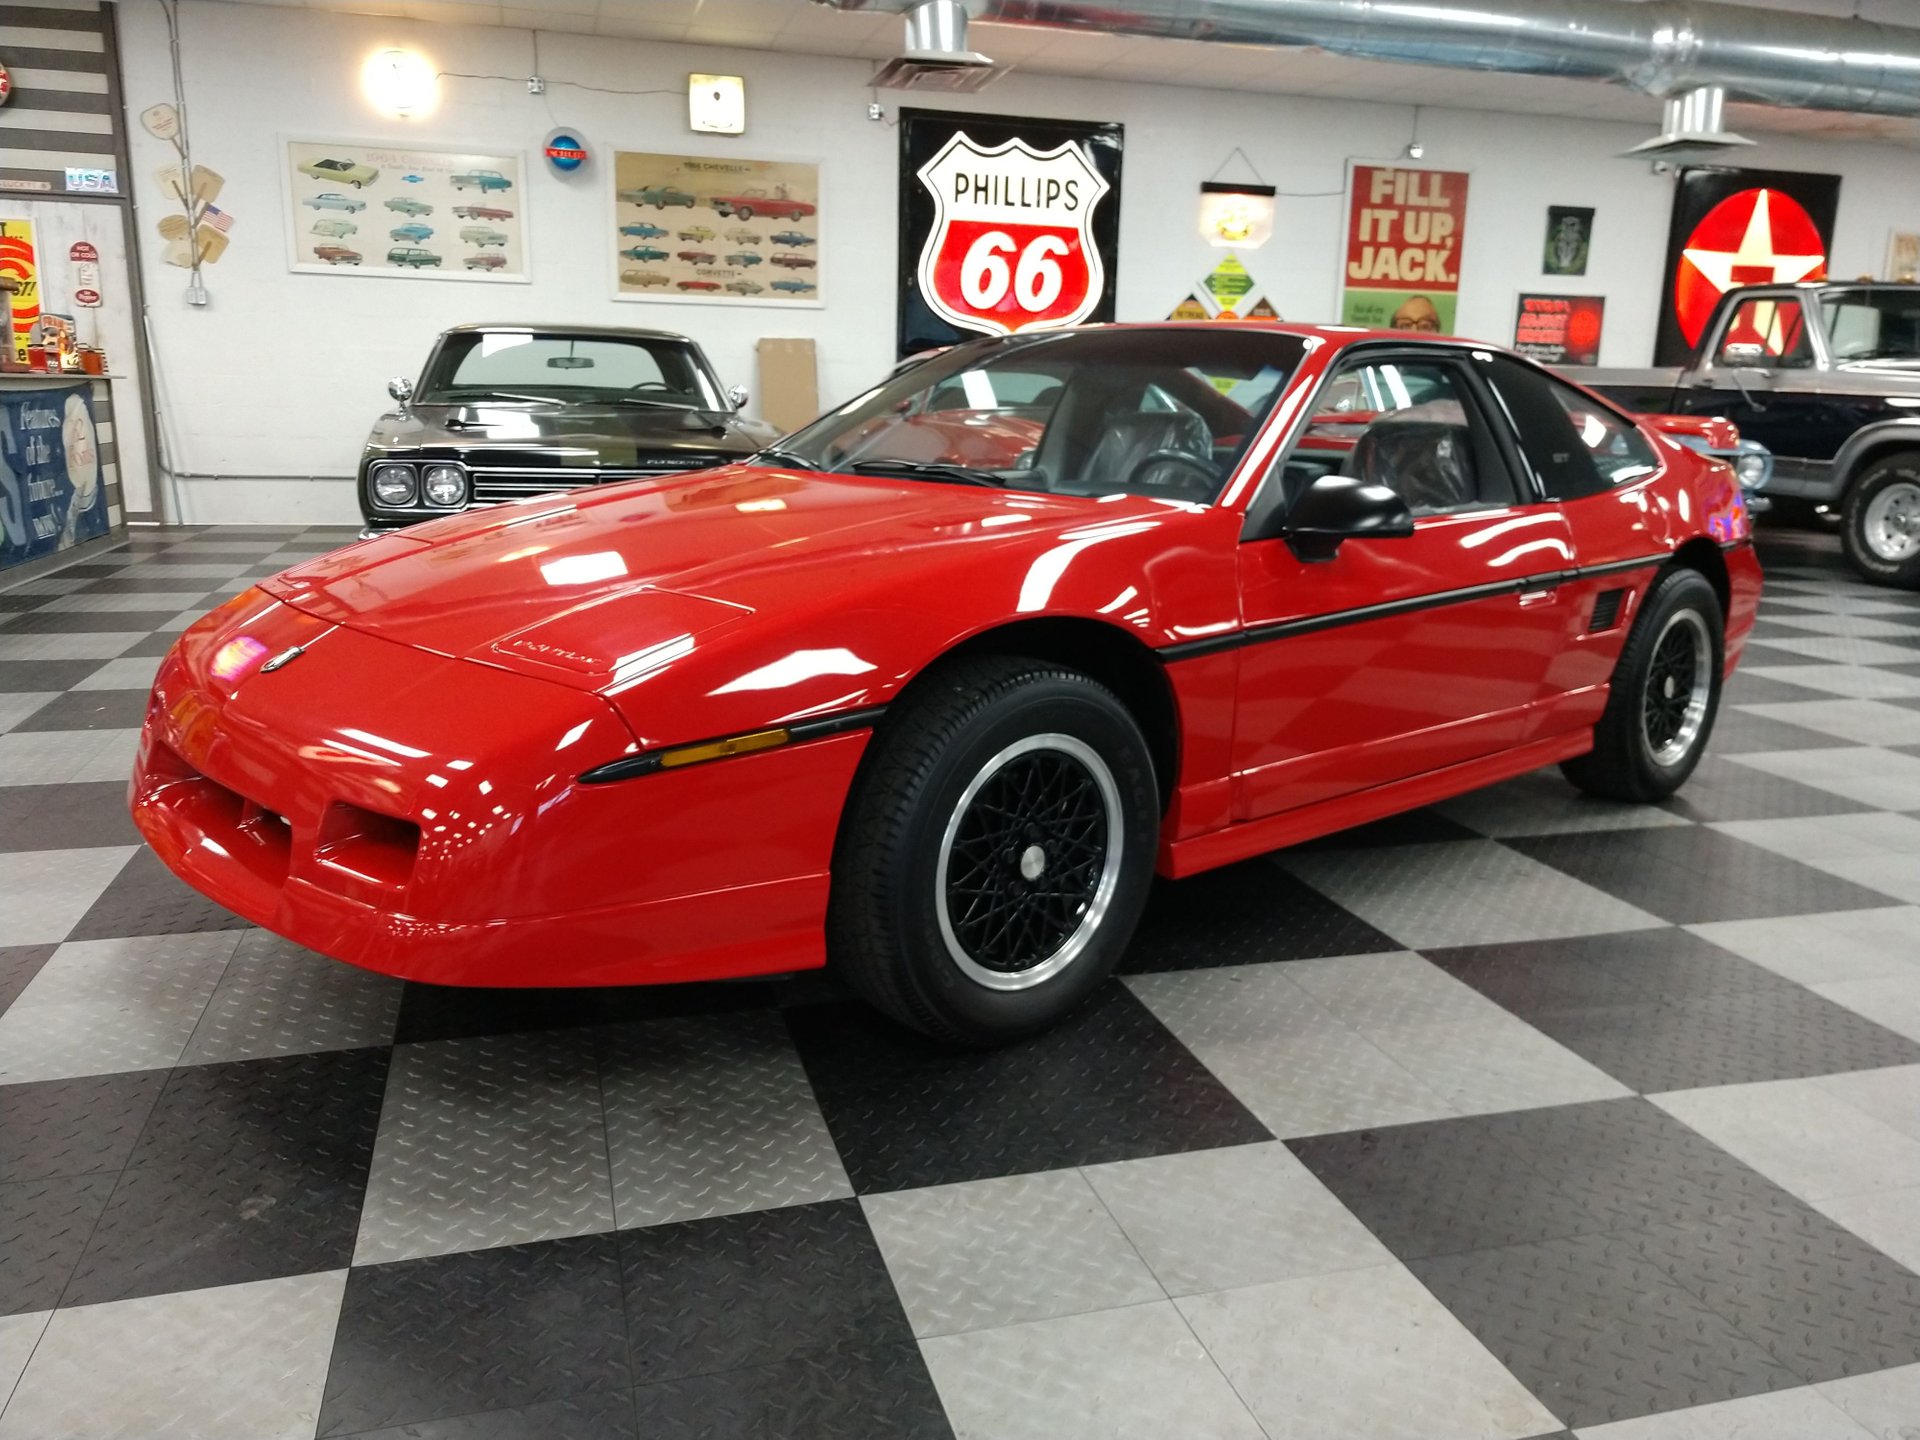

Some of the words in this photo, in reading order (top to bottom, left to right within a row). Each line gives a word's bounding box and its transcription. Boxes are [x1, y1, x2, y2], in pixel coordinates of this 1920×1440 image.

[67, 173, 116, 190] USA
[954, 172, 1079, 211] PHILLIPS
[1370, 167, 1450, 208] FILL
[1358, 208, 1399, 243] IT
[1402, 211, 1455, 250] UP,
[960, 230, 1070, 313] 66
[1348, 246, 1457, 283] JACK.
